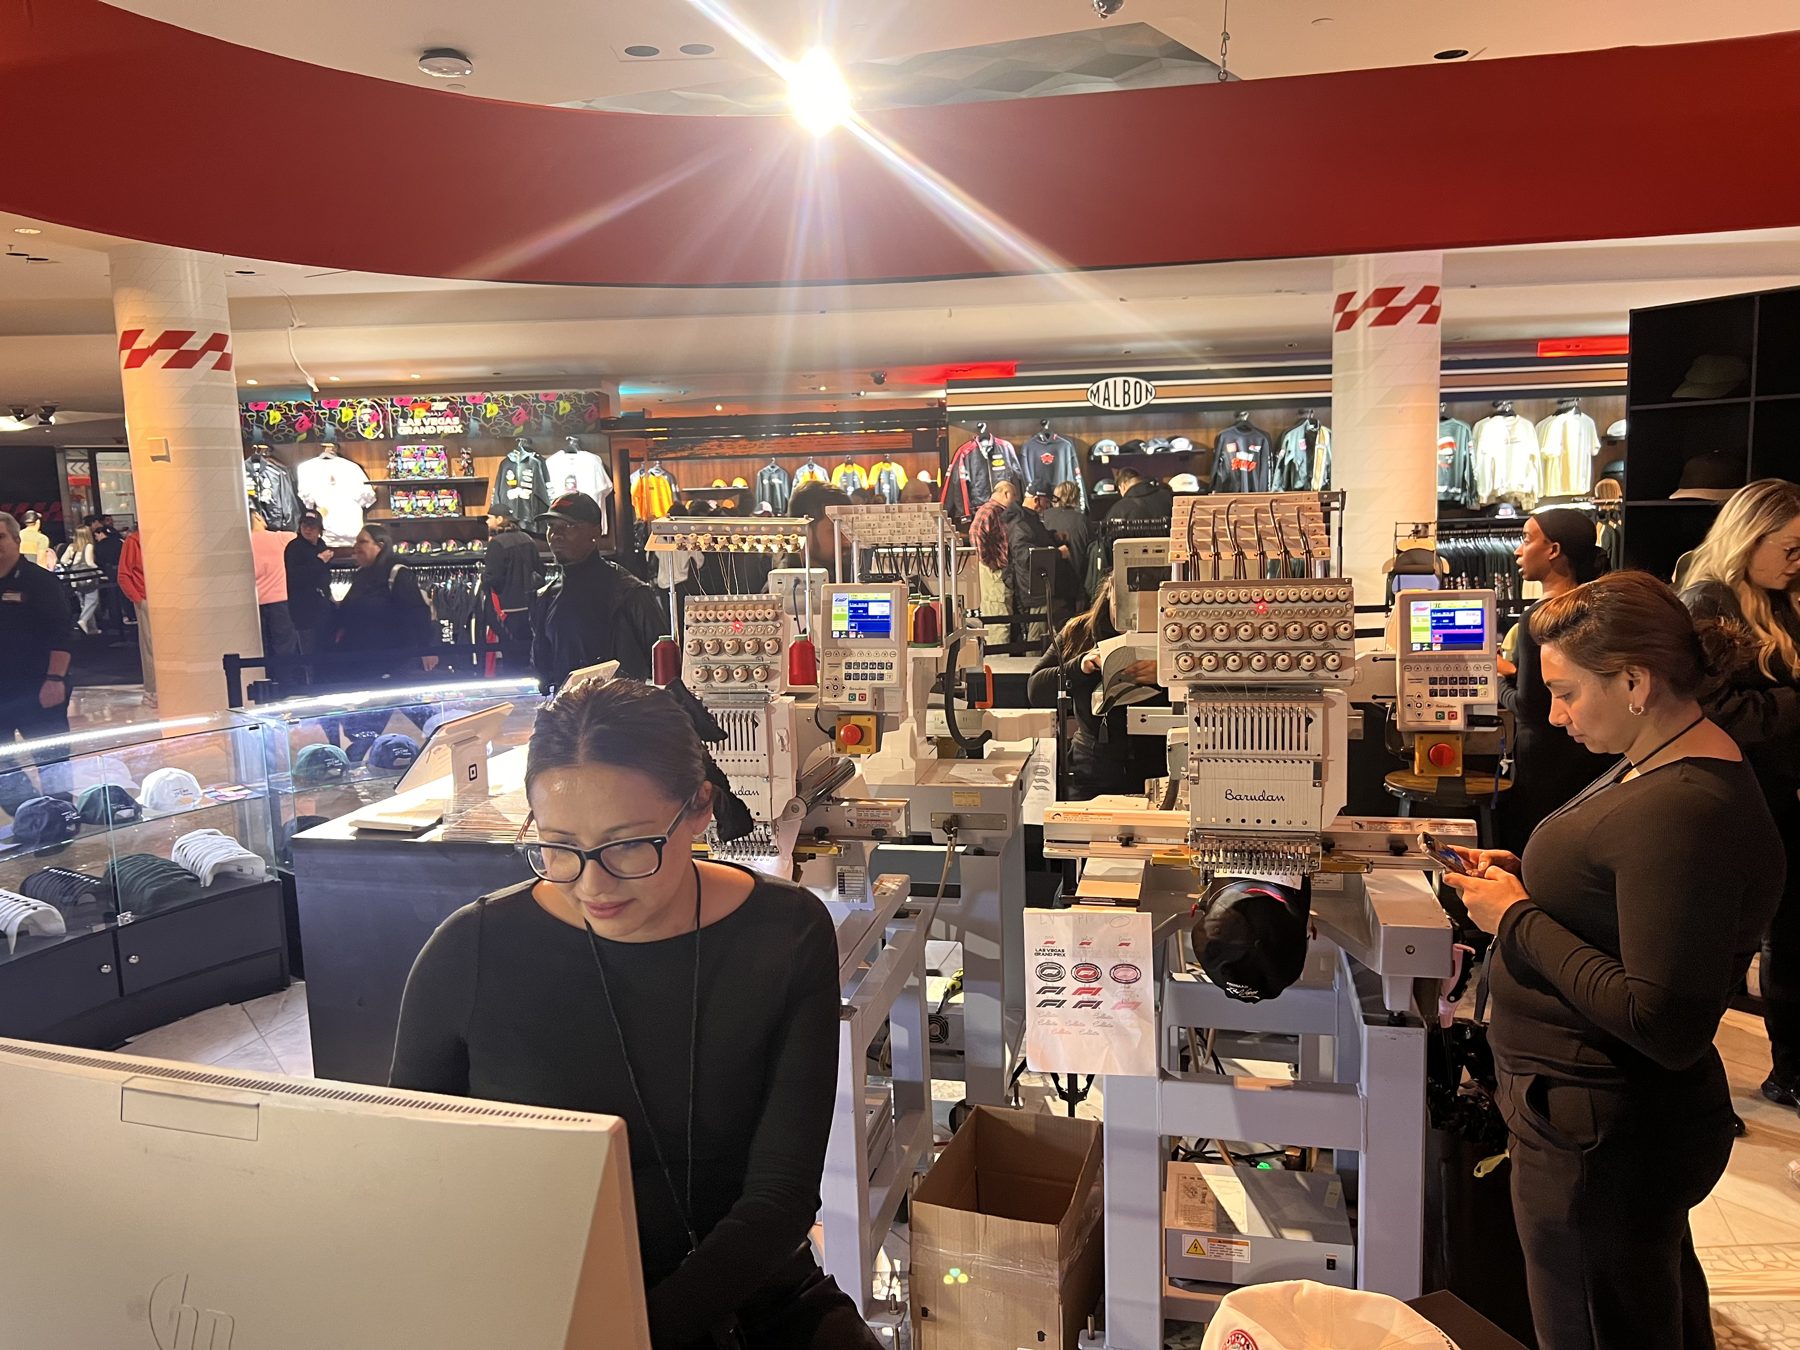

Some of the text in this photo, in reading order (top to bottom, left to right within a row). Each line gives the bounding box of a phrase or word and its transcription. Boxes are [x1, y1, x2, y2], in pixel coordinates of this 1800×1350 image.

[1089, 379, 1153, 408] MALBON
[398, 416, 460, 426] LAS VEGAS
[397, 424, 464, 435] GRAND PRIX
[731, 786, 760, 796] udan
[1224, 788, 1286, 802] Barudan
[1035, 986, 1067, 995] F1
[1072, 987, 1103, 996] F1
[1036, 999, 1068, 1008] F1
[1072, 1000, 1104, 1009] F1
